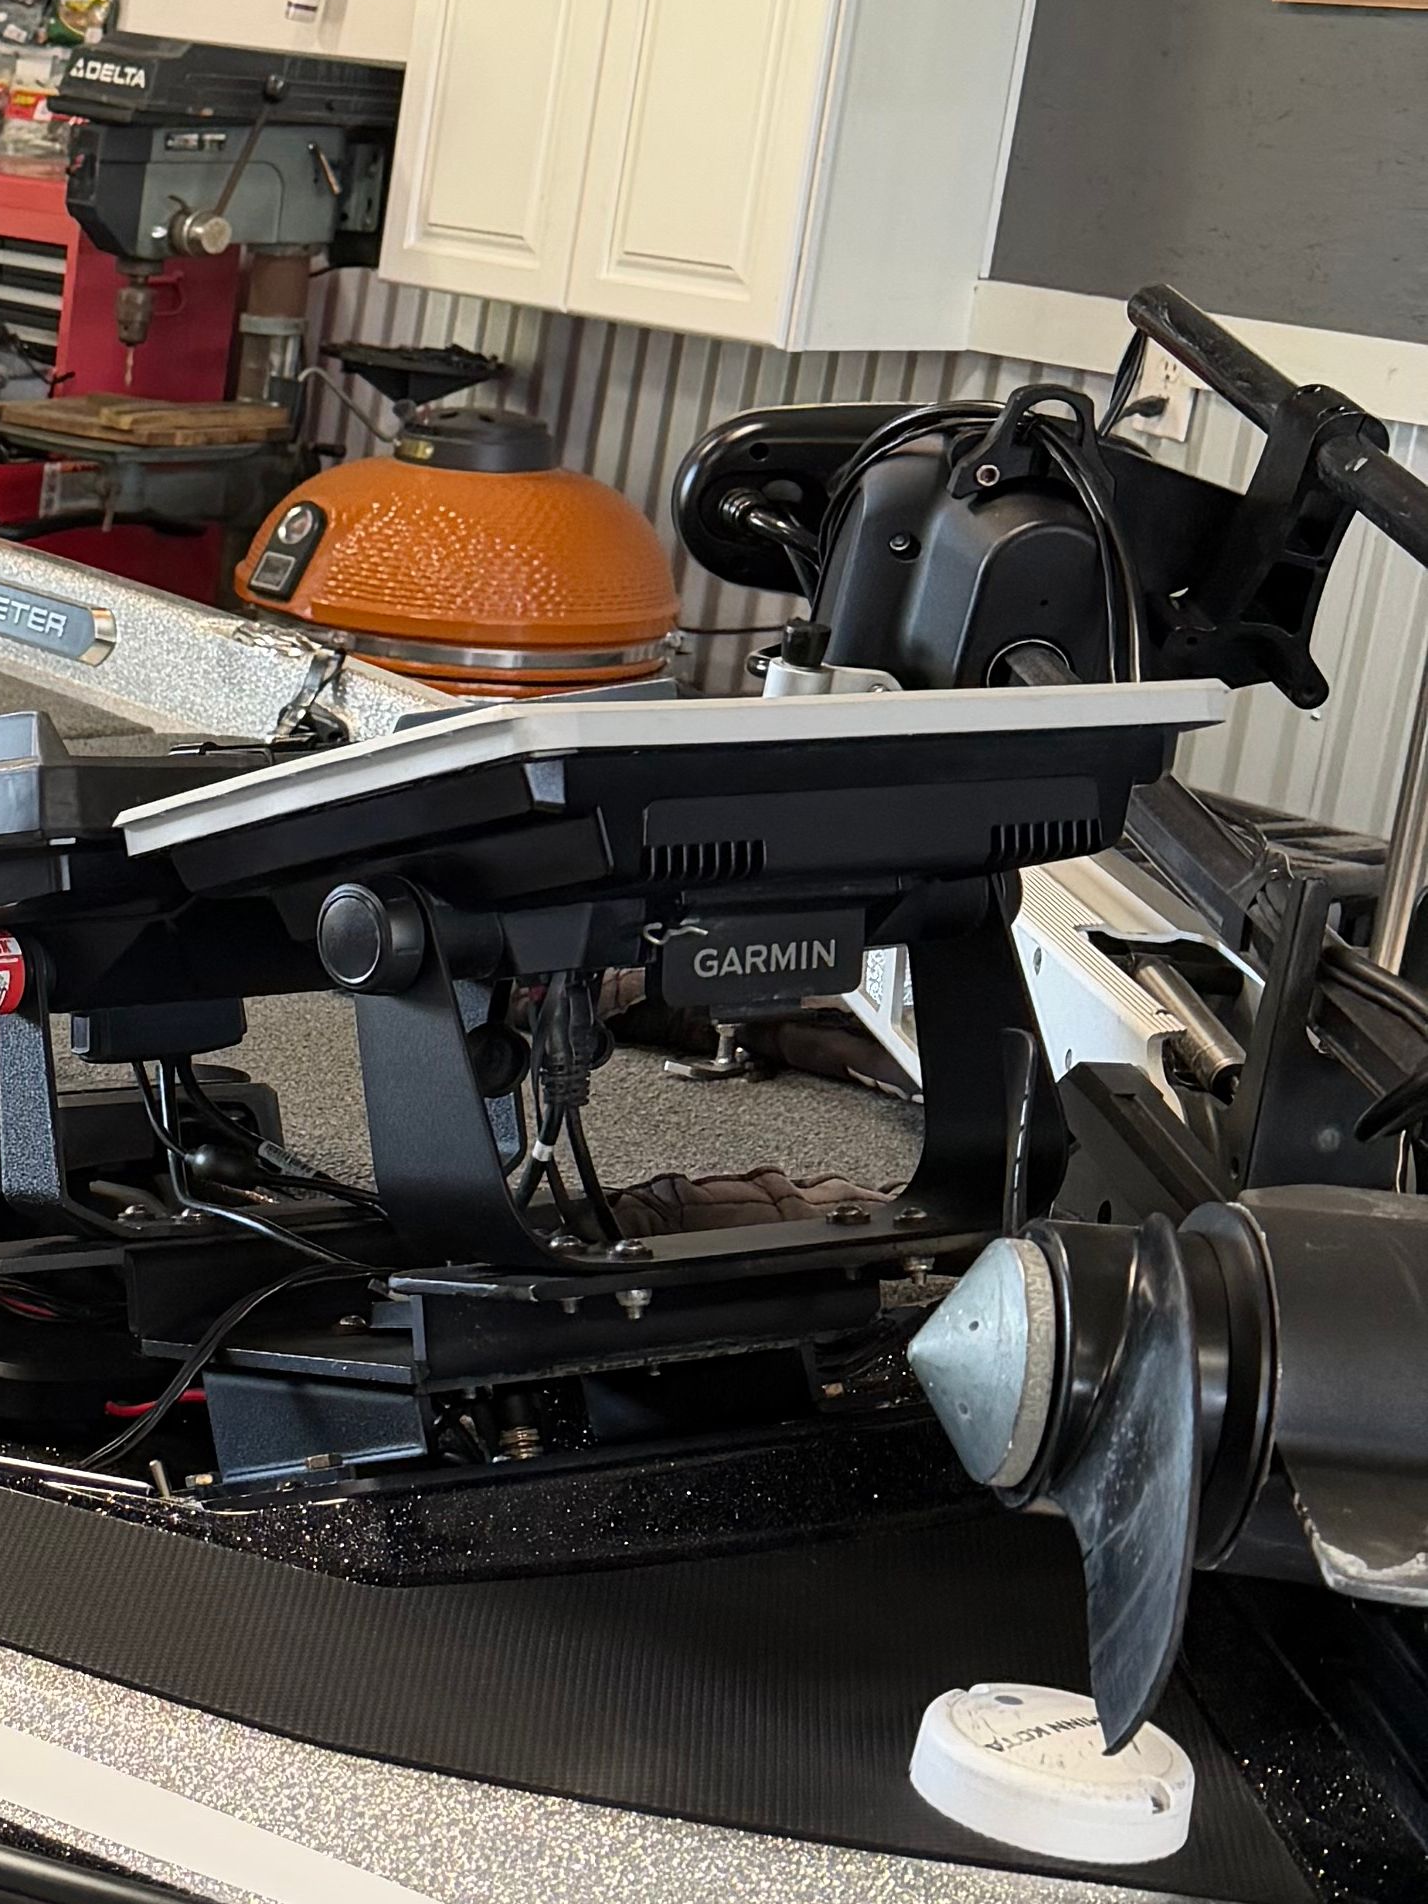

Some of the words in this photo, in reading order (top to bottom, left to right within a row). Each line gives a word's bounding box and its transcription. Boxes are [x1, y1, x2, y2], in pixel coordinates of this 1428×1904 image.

[85, 60, 146, 89] DELTA
[694, 939, 836, 979] GARMIN
[985, 1726, 1051, 1752] KOTA
